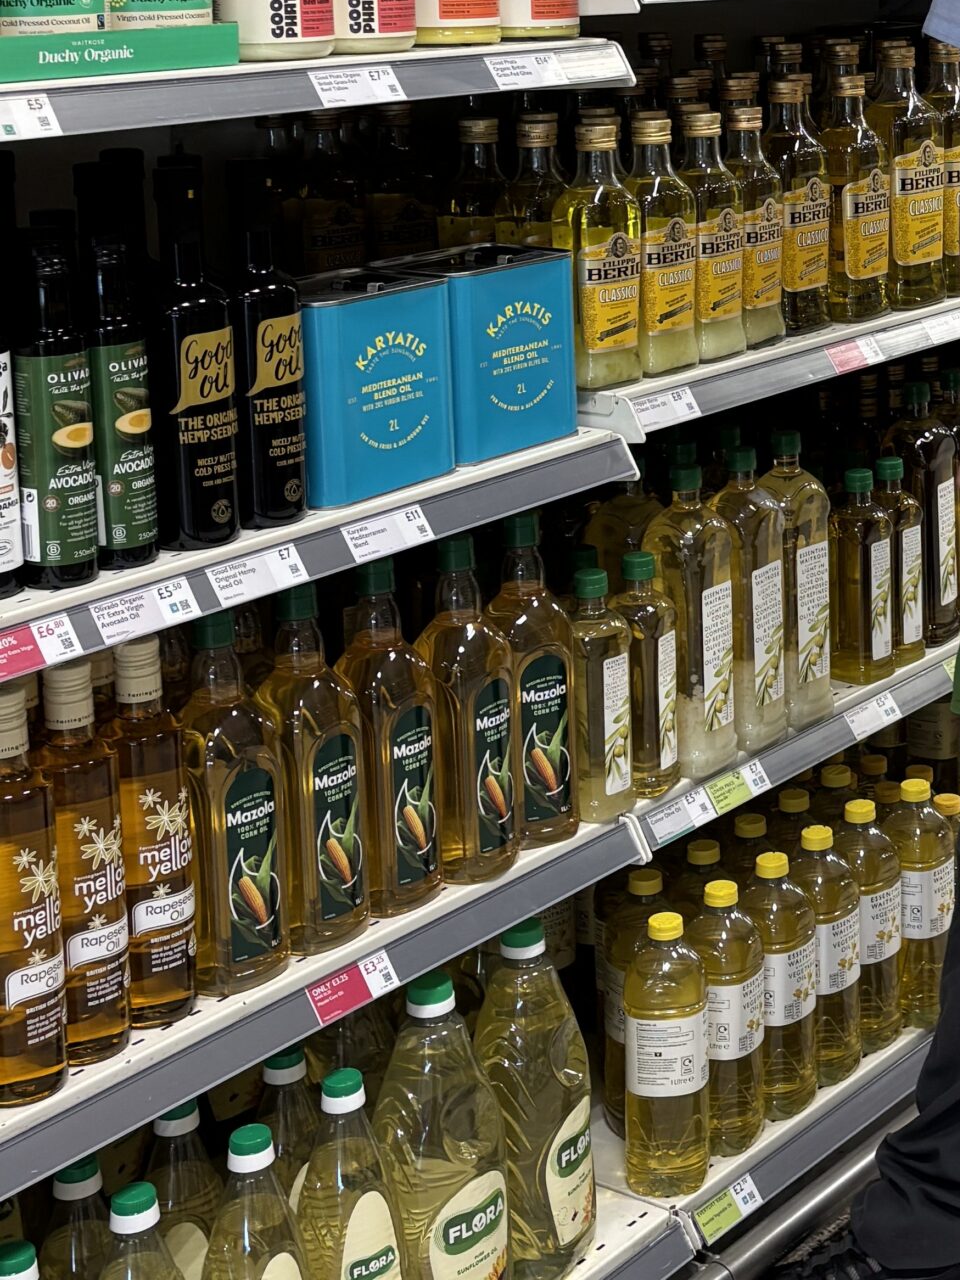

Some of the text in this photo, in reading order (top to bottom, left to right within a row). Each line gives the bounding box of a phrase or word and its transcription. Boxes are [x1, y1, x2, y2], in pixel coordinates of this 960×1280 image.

[38, 45, 134, 65] Duchy Organic
[914, 167, 941, 177] FILIPPO
[909, 196, 943, 216] CLASSICO
[662, 241, 691, 252] FILIPPO
[602, 258, 636, 269] FILIPPO
[658, 268, 693, 287] CLASSICO
[599, 285, 637, 304] CLASSICO
[486, 301, 552, 338] KARYATIS
[355, 331, 427, 371] KARYATIS
[492, 339, 549, 359] MEDITERRANEAN
[503, 350, 538, 365] BLEND OIL
[185, 339, 233, 400] Good oil
[361, 371, 424, 394] MEDITERRANEAN
[373, 384, 412, 400] BLEND OIL
[517, 382, 527, 394] 2L
[178, 415, 205, 432] THE
[389, 418, 400, 432] 2L
[113, 456, 151, 476] AVOCADO
[49, 473, 90, 490] AVOCADO
[405, 509, 421, 522] £11
[278, 547, 290, 560] £7
[211, 562, 247, 577] Good Hemp
[215, 567, 256, 584] Original Hemp
[218, 579, 243, 591] Seed Oil
[93, 594, 145, 613] Olivado Organic
[97, 603, 145, 622] FT Extra Virgin
[101, 612, 140, 629] Avocado Oil
[521, 683, 566, 704] Mazola
[530, 698, 561, 711] 100% PURE
[533, 705, 560, 716] CORN OIL
[393, 735, 432, 759] Mazola
[314, 763, 356, 791] Mazola
[226, 800, 275, 827] Mazola
[170, 908, 184, 921] Oil
[312, 973, 349, 997] ONLY £3.25
[448, 1197, 503, 1245] FLORA
[353, 1252, 395, 1279] FLORA
[457, 1252, 491, 1276] SUNFLOWER
